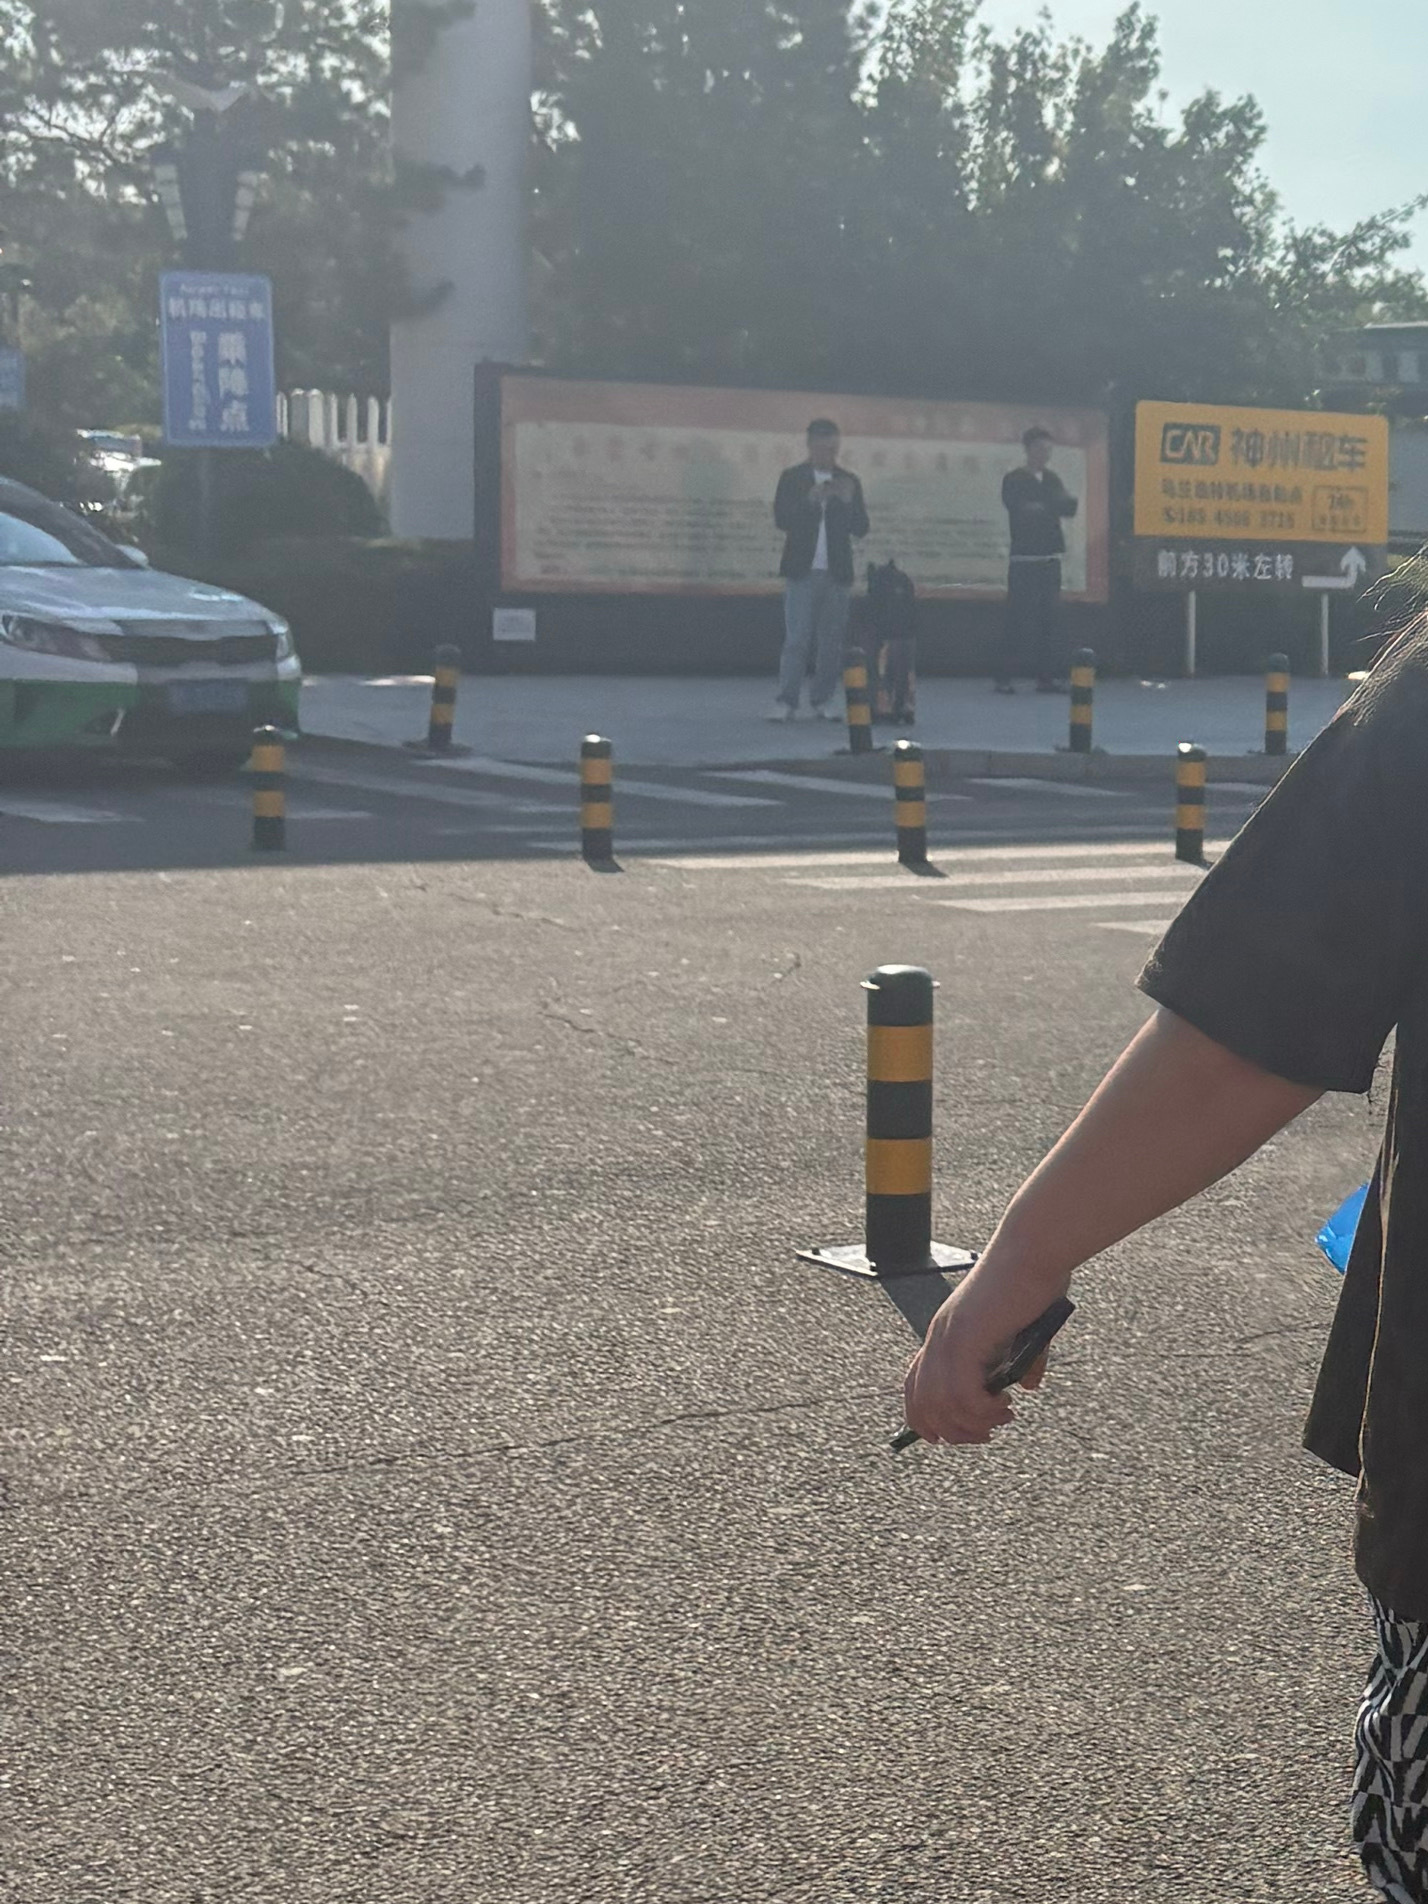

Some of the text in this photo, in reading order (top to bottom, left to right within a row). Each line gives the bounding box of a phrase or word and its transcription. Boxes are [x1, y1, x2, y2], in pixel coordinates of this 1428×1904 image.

[1230, 427, 1368, 473] 神州租车
[1157, 549, 1295, 581] 前方30米左转
